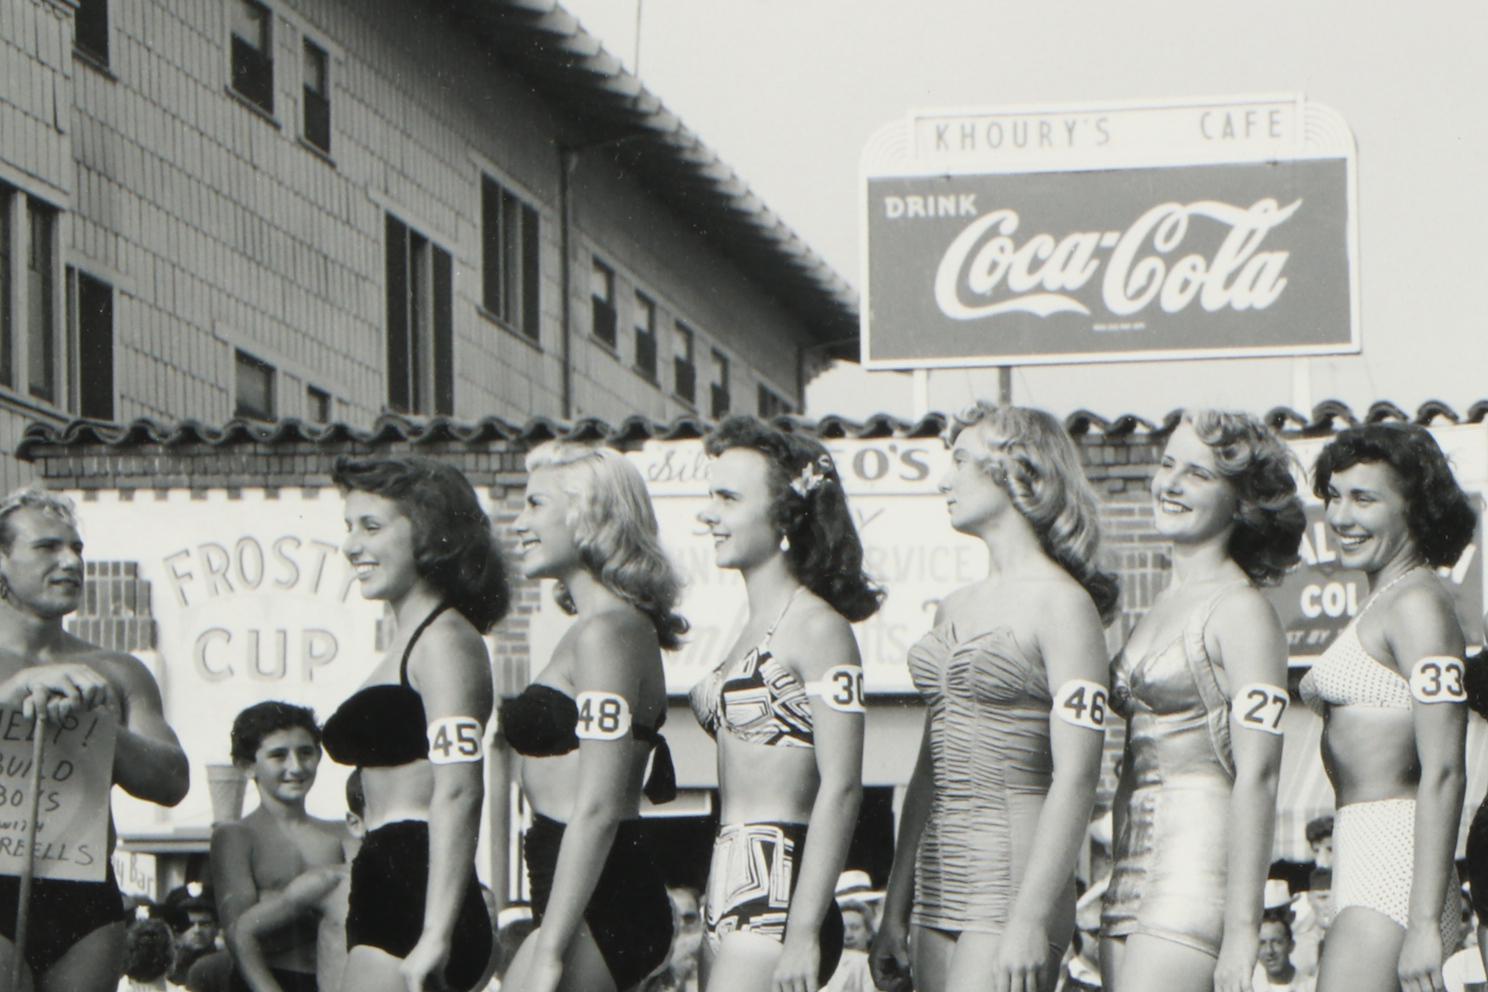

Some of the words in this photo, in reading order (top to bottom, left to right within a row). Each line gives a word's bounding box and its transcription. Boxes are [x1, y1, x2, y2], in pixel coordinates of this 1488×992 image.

[935, 117, 1111, 151] KHOURY'S
[1200, 110, 1283, 141] CAFE
[885, 193, 978, 219] DRINK
[935, 198, 1303, 320] Coca-Cola
[192, 626, 339, 683] CUP
[1420, 662, 1464, 697] 33
[578, 698, 622, 733] 48
[1063, 685, 1107, 726] 46
[1243, 688, 1289, 729] 27
[0, 707, 99, 748] ELP!
[432, 722, 479, 757] 45
